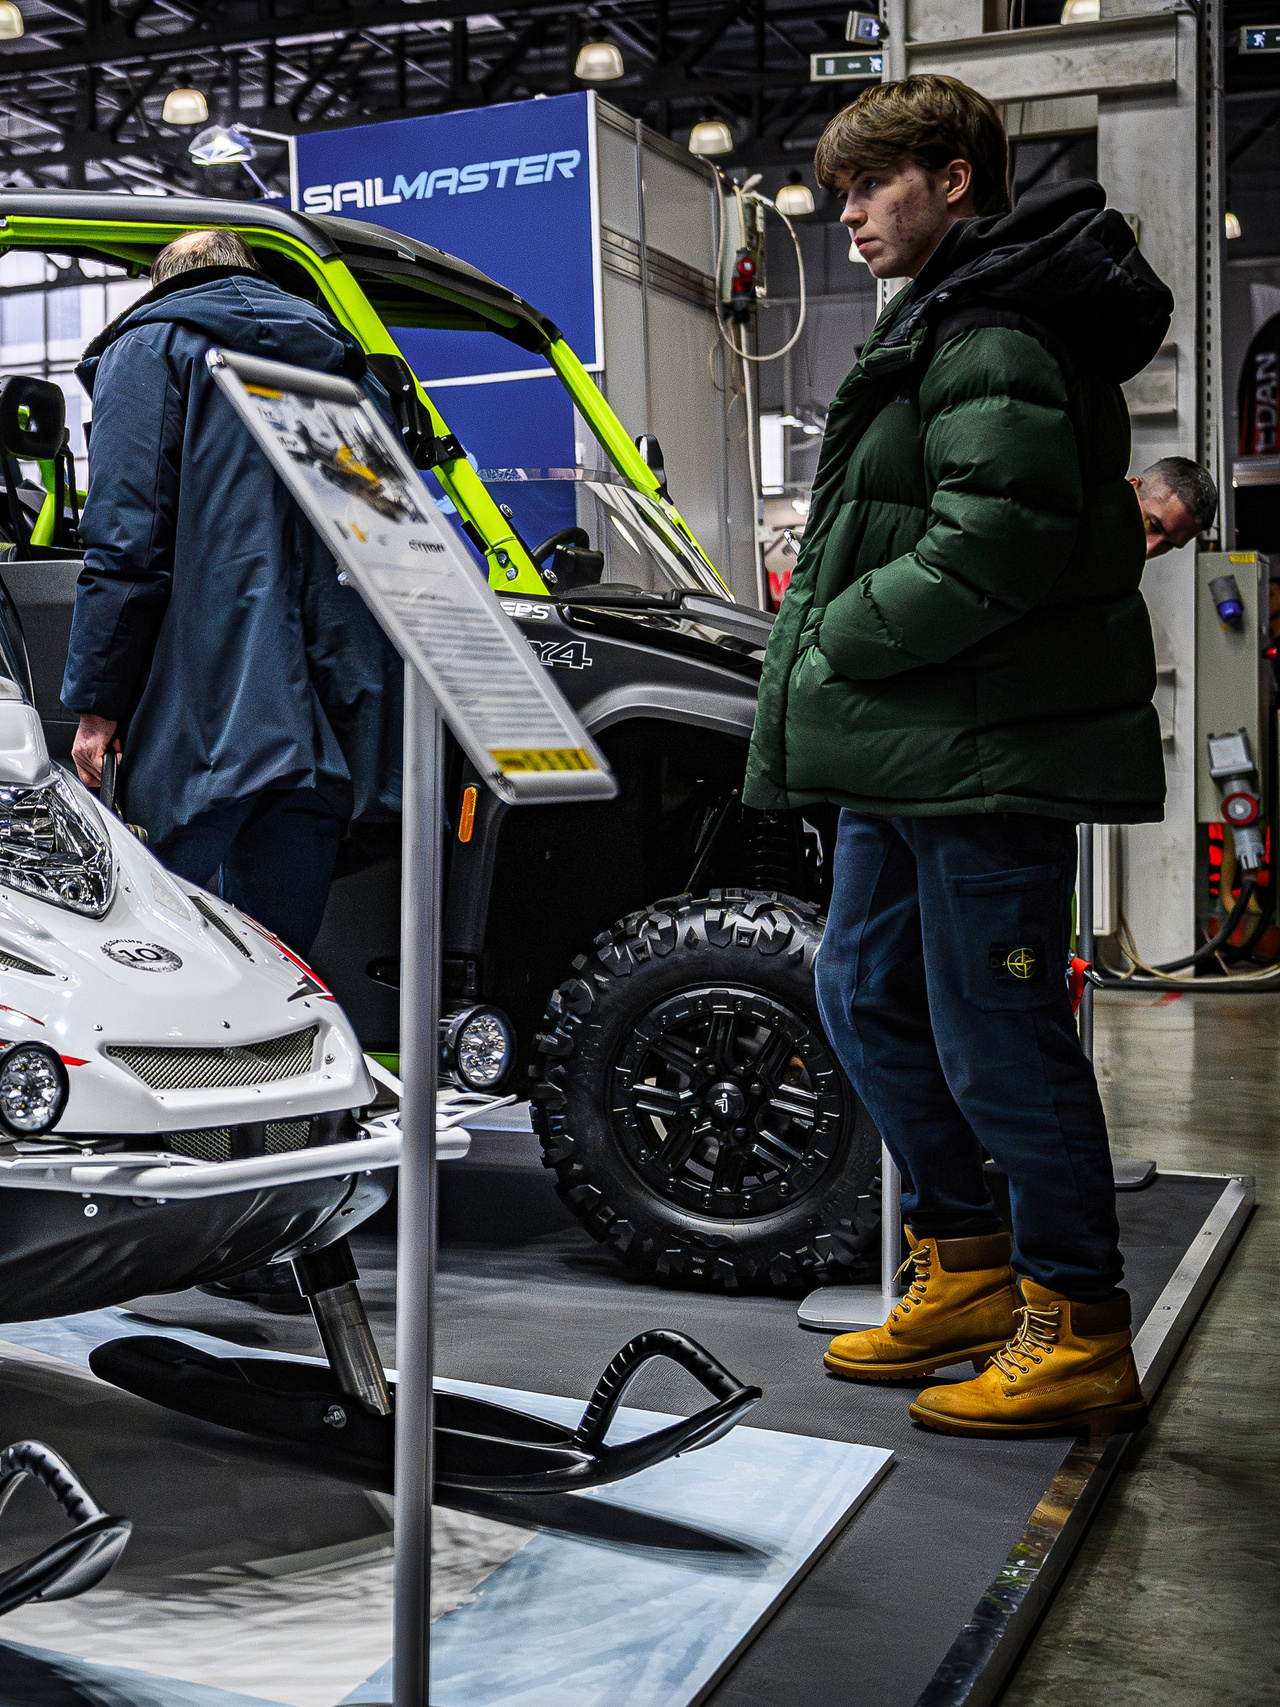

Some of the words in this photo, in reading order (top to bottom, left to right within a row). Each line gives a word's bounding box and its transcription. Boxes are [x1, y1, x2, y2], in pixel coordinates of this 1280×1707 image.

[302, 149, 581, 214] SAILMASTER
[499, 601, 550, 620] EPS
[117, 947, 163, 962] 10
